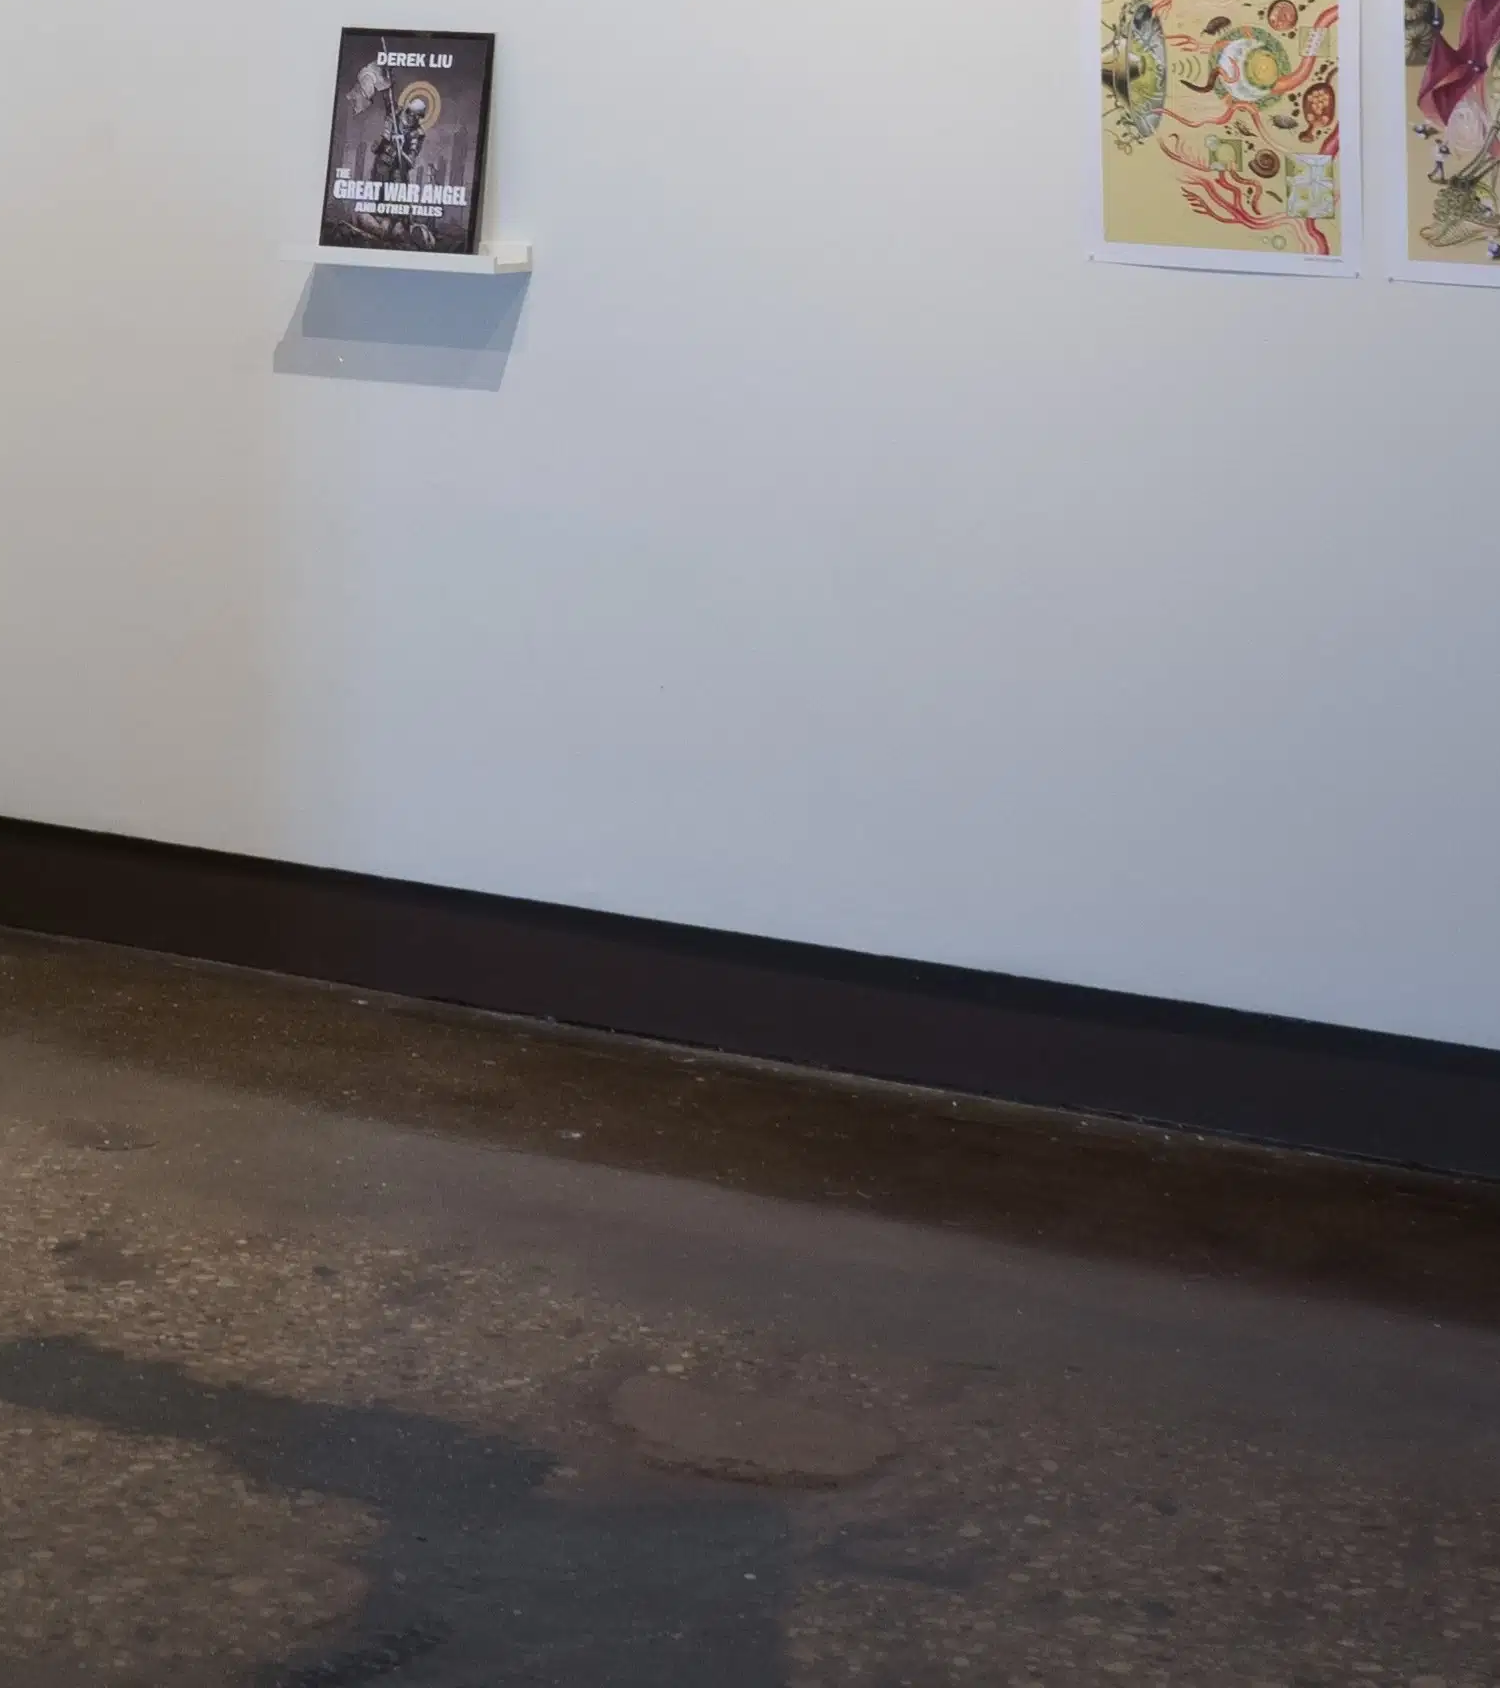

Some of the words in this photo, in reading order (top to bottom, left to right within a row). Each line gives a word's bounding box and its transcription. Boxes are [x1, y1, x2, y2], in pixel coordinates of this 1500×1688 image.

[377, 51, 425, 68] DEREK
[429, 52, 453, 69] LIU
[335, 168, 352, 179] THE
[333, 181, 383, 201] GREAT
[384, 182, 421, 203] WAR
[422, 184, 468, 206] ANGEL
[355, 204, 378, 214] AND
[378, 204, 411, 216] OTHER
[411, 205, 443, 217] TALES
